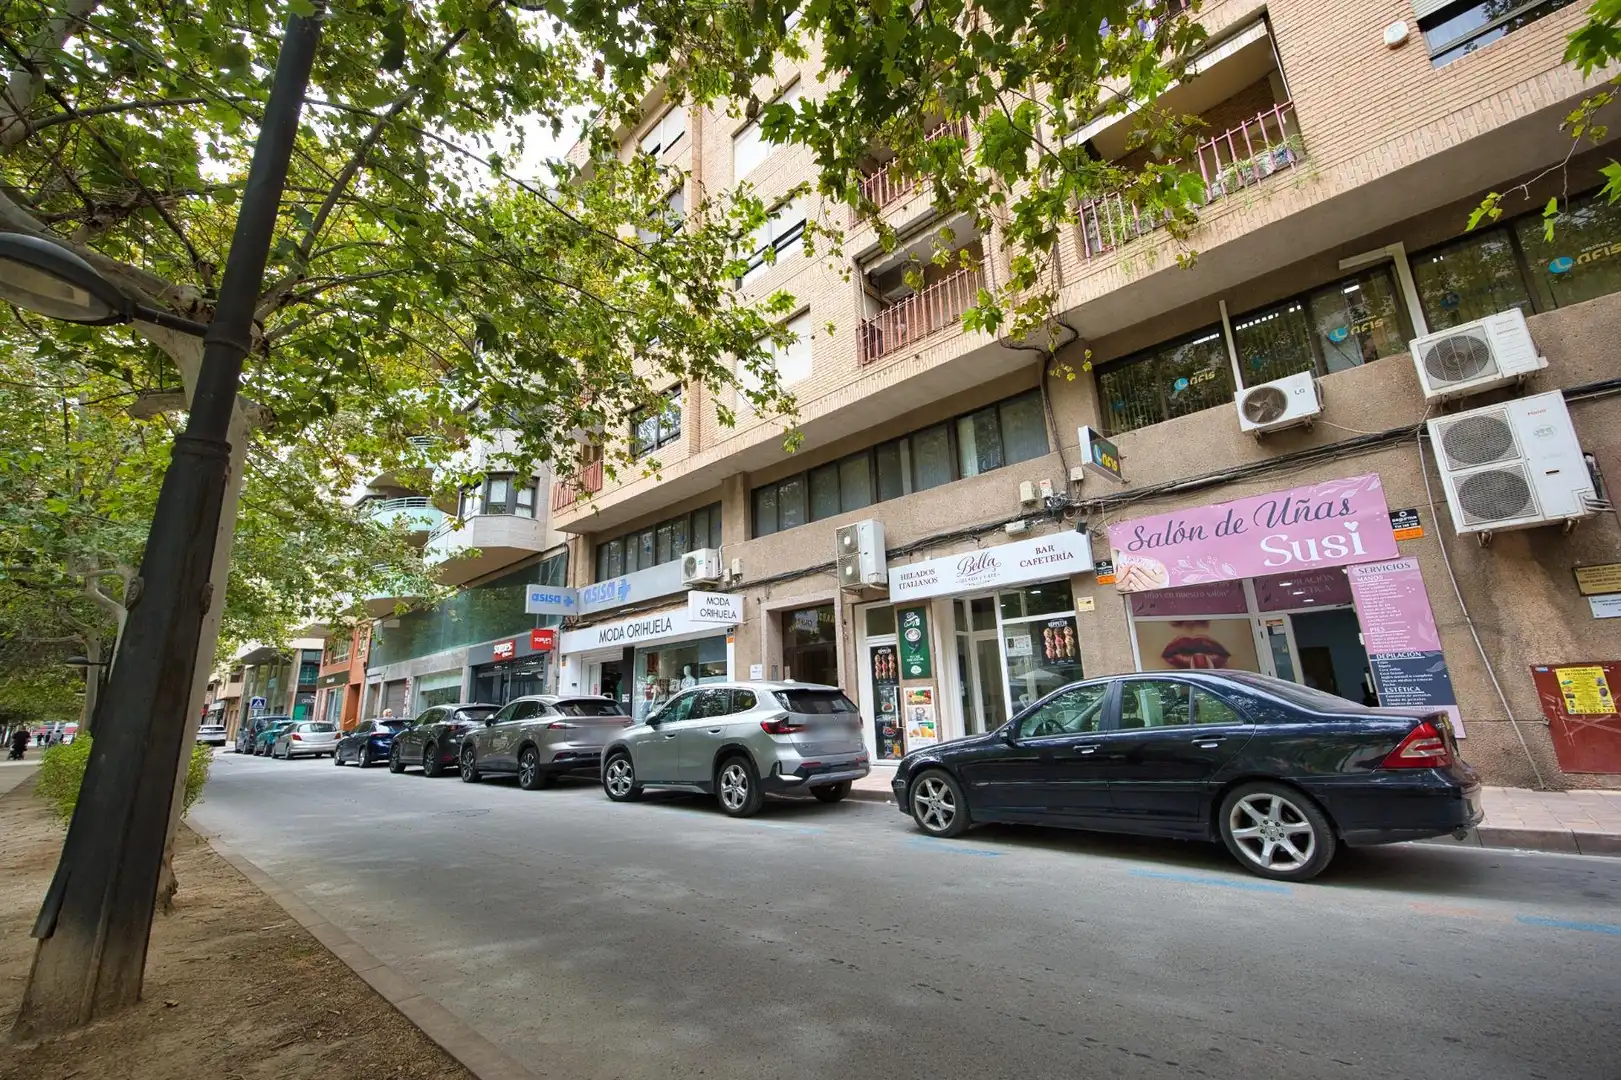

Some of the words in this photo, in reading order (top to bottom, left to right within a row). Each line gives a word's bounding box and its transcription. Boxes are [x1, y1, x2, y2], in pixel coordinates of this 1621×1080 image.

[1127, 519, 1208, 552] Salón
[1215, 508, 1248, 537] de
[1254, 496, 1358, 529] Uñas
[1035, 544, 1055, 554] BAR
[1259, 521, 1367, 567] Susi
[957, 552, 1002, 577] Bella
[1019, 551, 1074, 568] CAFETERÍA
[900, 568, 935, 580] HELADOS
[1358, 562, 1411, 574] SERVICIOS
[899, 577, 938, 590] ITALIANOS
[531, 593, 561, 603] asisa
[584, 582, 616, 604] asisa
[706, 597, 730, 606] MODA
[700, 608, 737, 619] ORIHUELA
[599, 628, 624, 643] MODA
[627, 617, 672, 640] ORIHUELA
[1376, 651, 1421, 659] DEPILACIÓN
